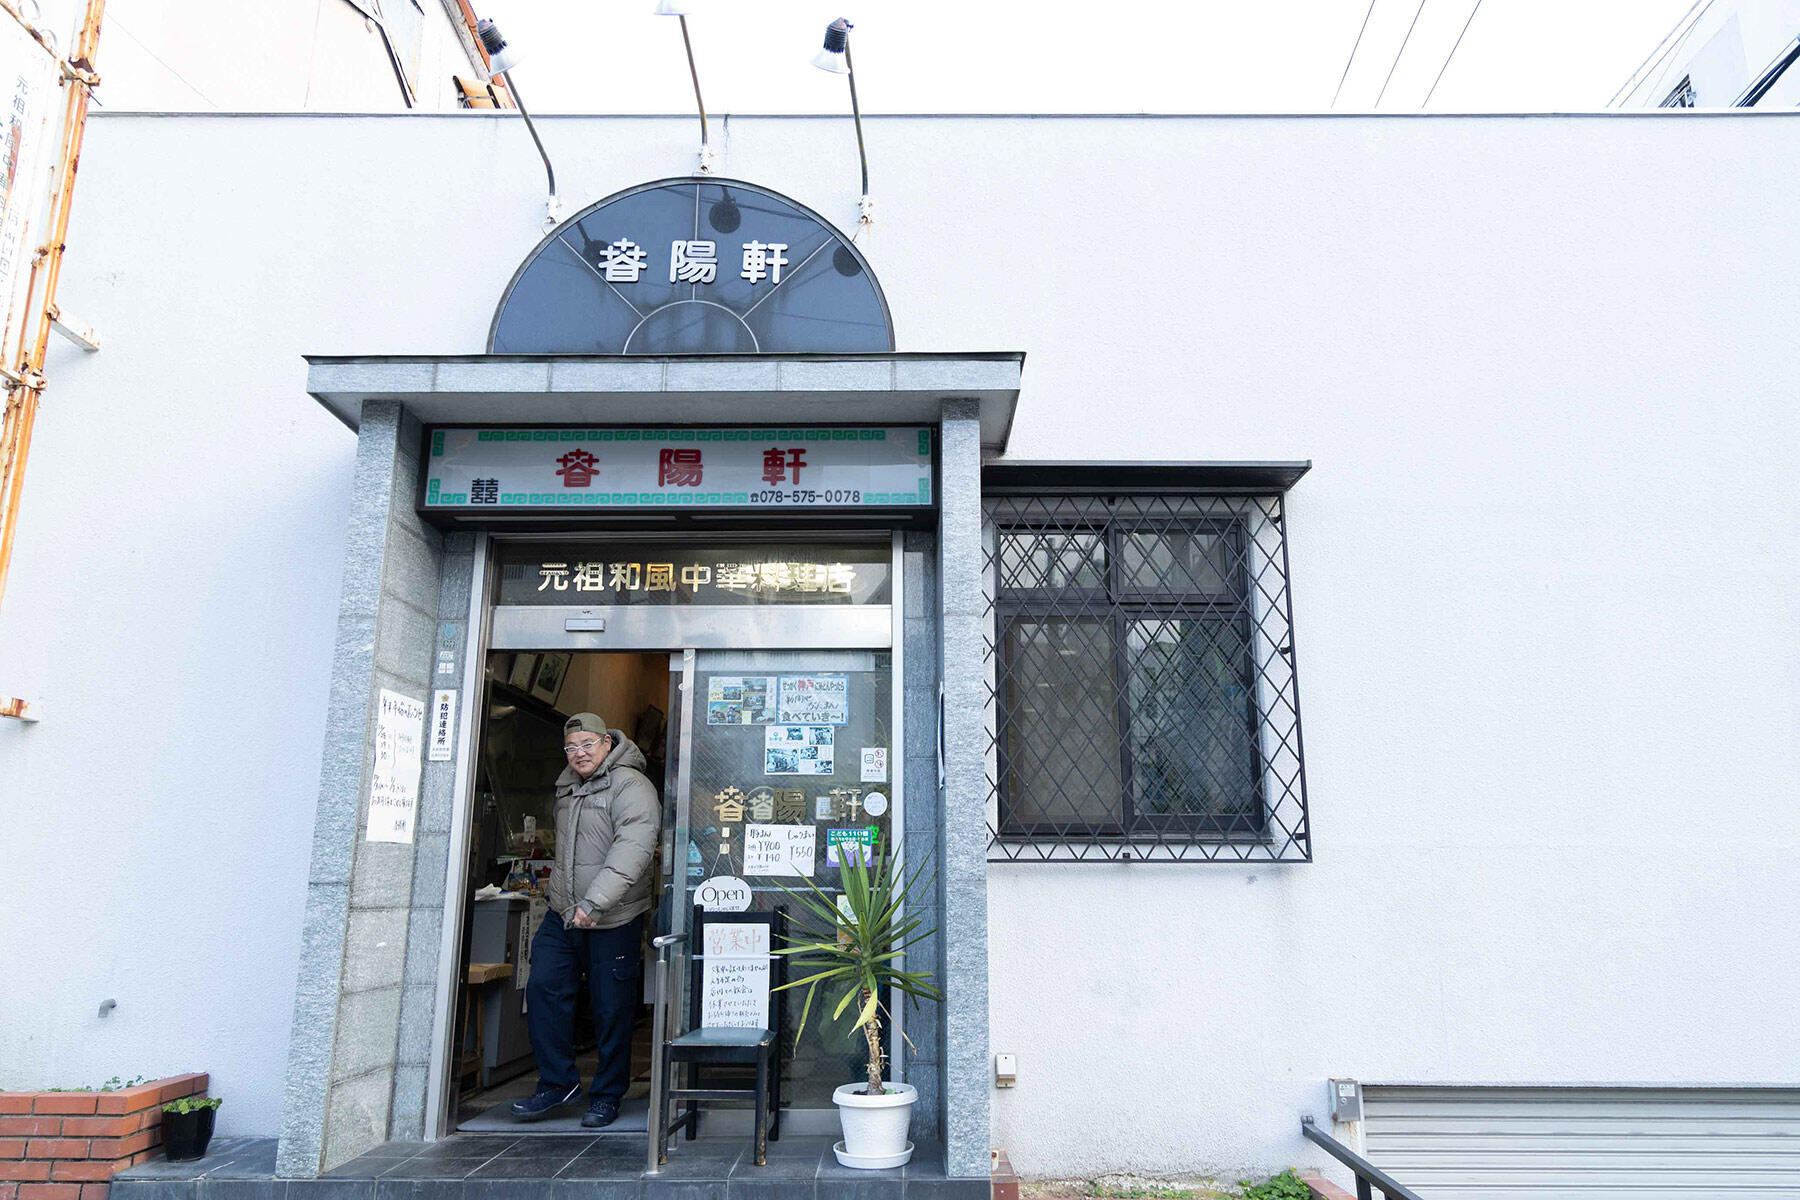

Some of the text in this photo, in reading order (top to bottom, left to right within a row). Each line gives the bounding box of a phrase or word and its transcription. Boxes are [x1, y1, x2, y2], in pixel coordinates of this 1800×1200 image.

[758, 490, 861, 504] 078-575-0078
[436, 703, 449, 746] 防犯連絡所
[790, 845, 813, 861] ¥550
[702, 887, 745, 906] Open
[708, 928, 761, 955] 営業中
